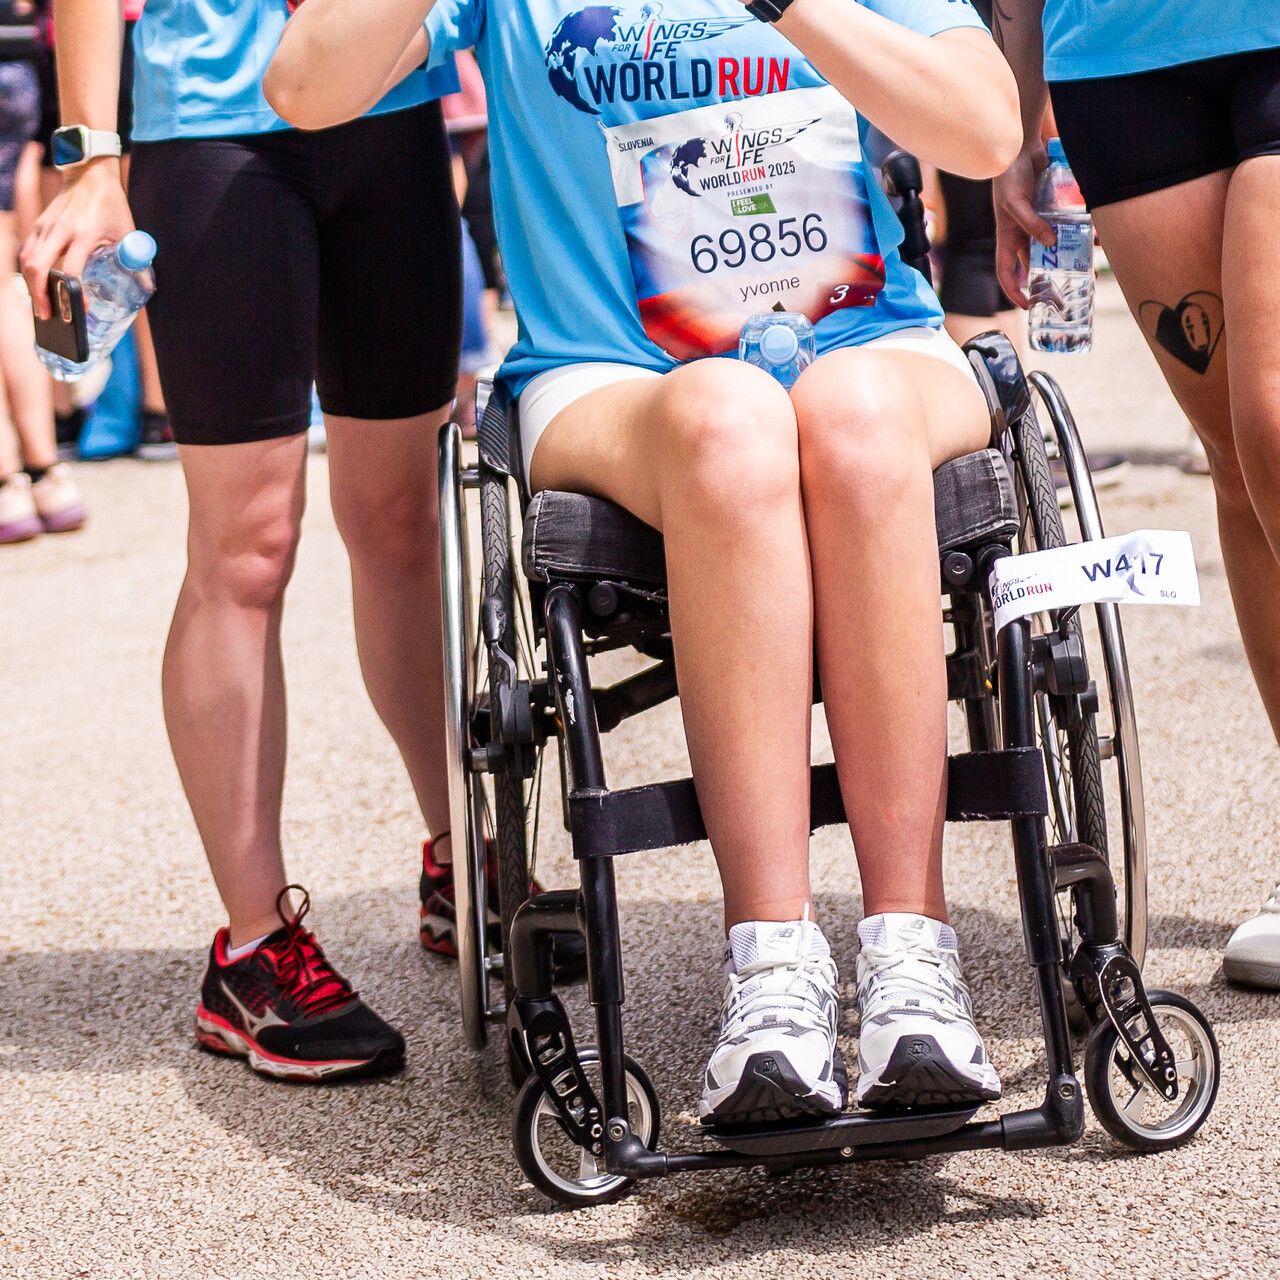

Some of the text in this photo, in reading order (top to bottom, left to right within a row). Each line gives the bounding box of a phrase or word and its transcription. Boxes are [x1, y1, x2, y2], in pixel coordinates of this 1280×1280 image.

[616, 20, 707, 42] WINGS
[612, 41, 682, 62] FOR LIFE
[583, 56, 790, 105] WORLD RUN
[618, 136, 655, 152] SLOVENIA
[710, 127, 782, 155] WINGS
[710, 147, 766, 170] FOR LIFE
[699, 160, 796, 191] WORLD RUN 2025
[727, 186, 763, 197] PRESENTED
[736, 197, 754, 207] FEEL
[689, 213, 828, 274] 69856
[739, 274, 801, 302] yvonne
[830, 284, 849, 303] 3
[1081, 552, 1163, 582] W417
[1026, 582, 1053, 596] RUN
[1160, 589, 1177, 599] SLO
